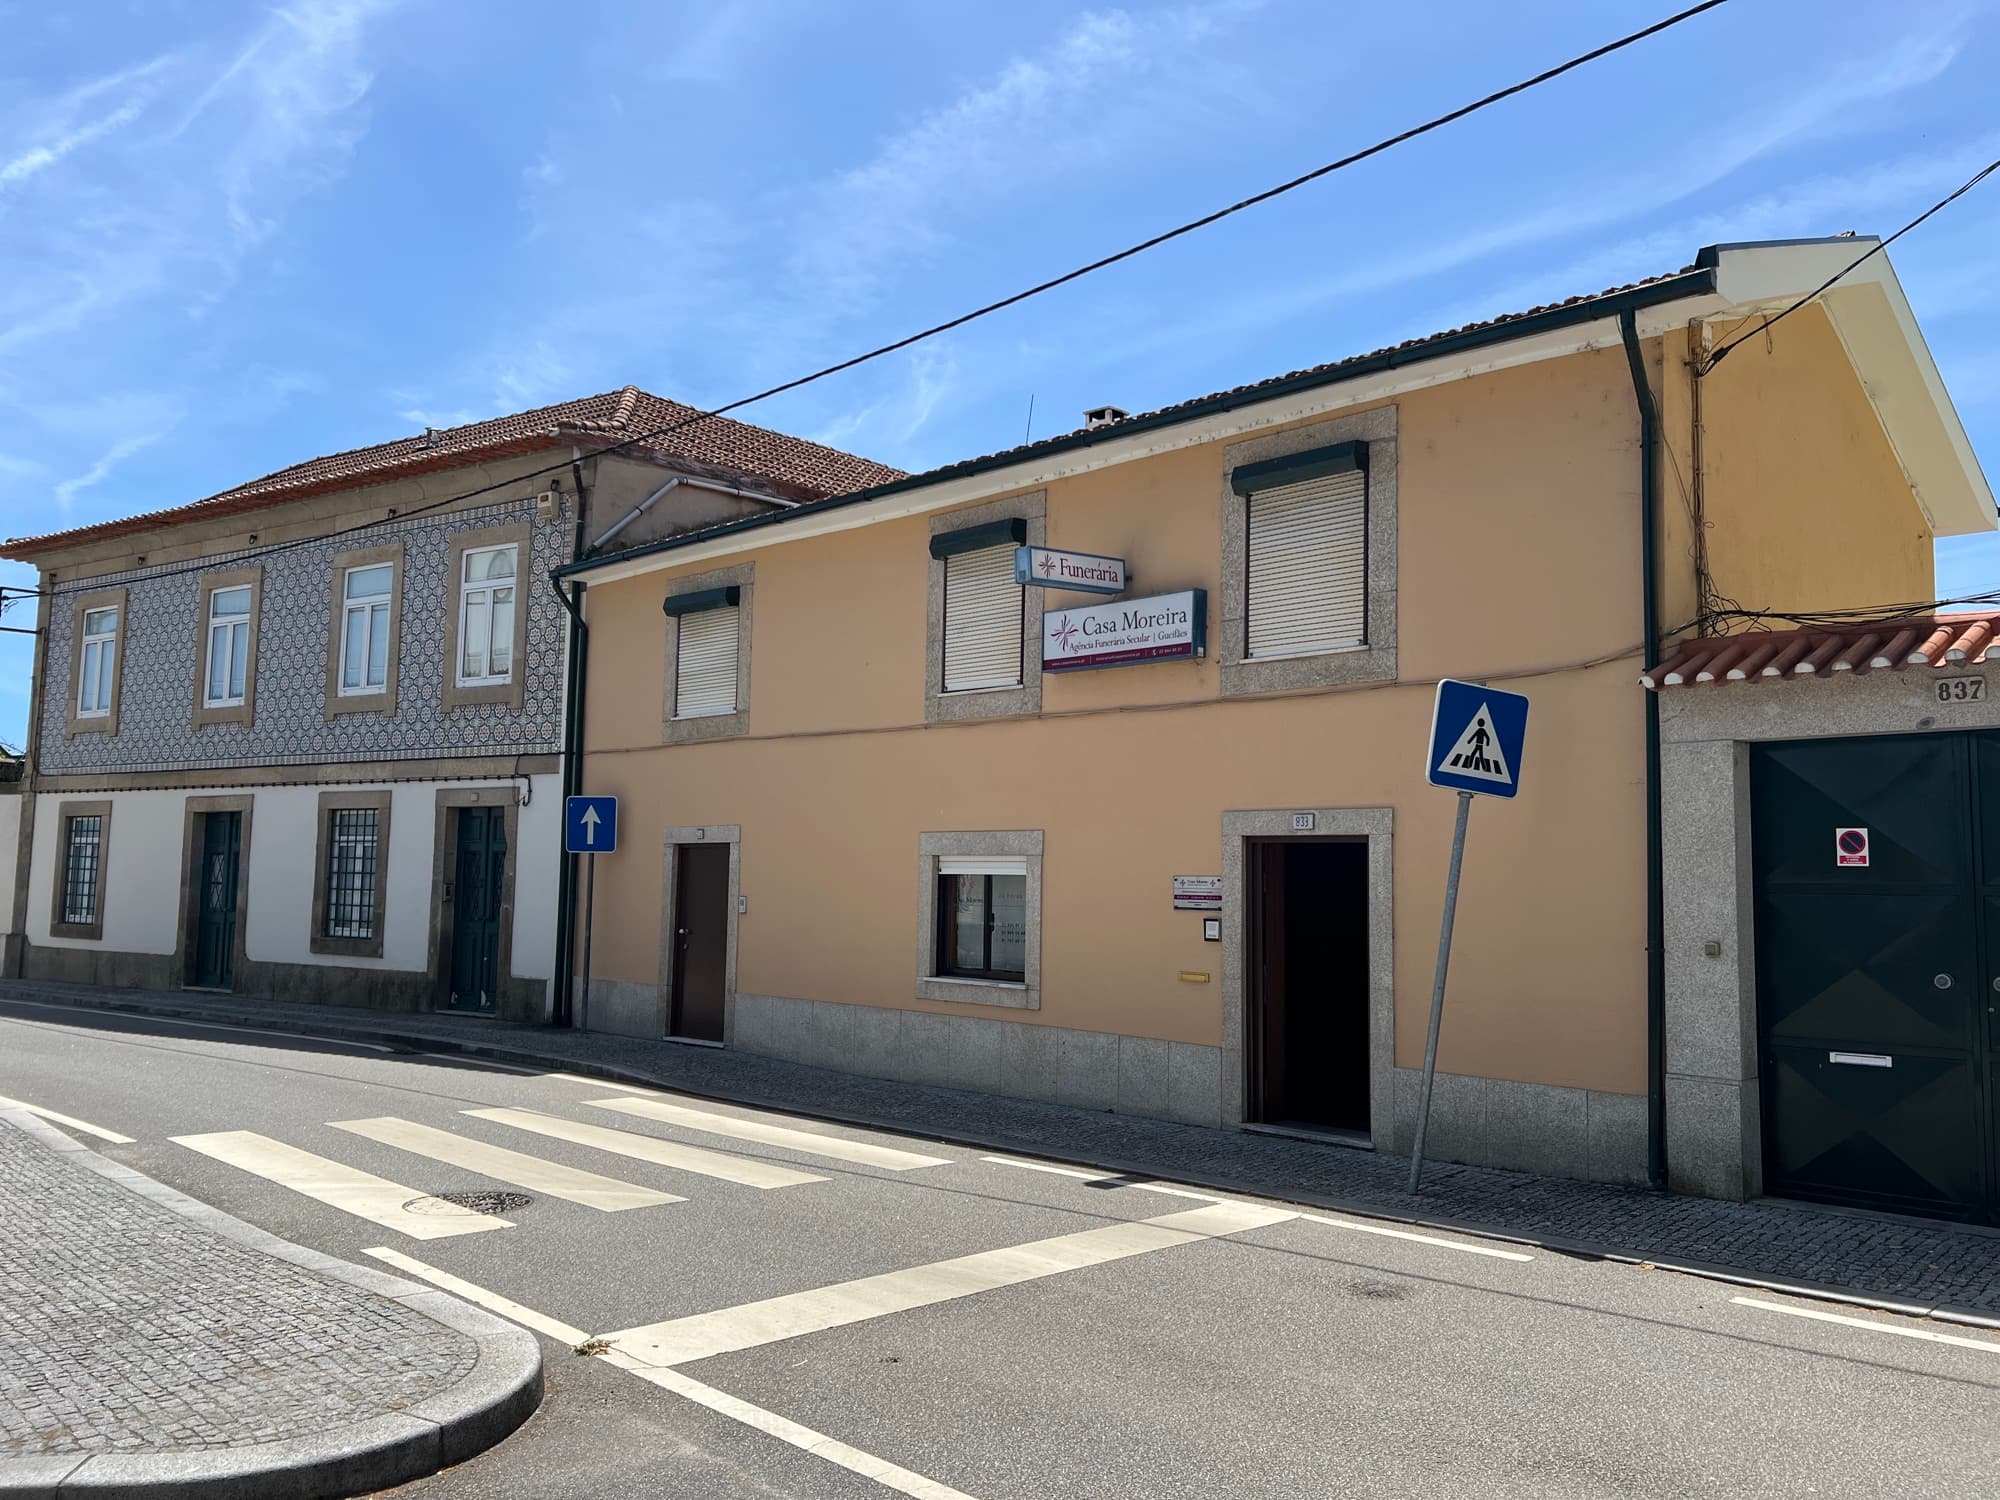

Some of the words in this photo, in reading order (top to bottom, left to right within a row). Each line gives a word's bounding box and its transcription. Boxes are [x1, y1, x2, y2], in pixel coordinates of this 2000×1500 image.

[1059, 558, 1118, 583] Funerária
[1082, 616, 1117, 636] Casa
[1122, 607, 1187, 631] Moreira
[1070, 641, 1094, 655] Agência
[1095, 637, 1125, 649] Funerária
[1126, 632, 1150, 645] Secular
[1938, 680, 1983, 701] 837
[1295, 815, 1309, 828] 833
